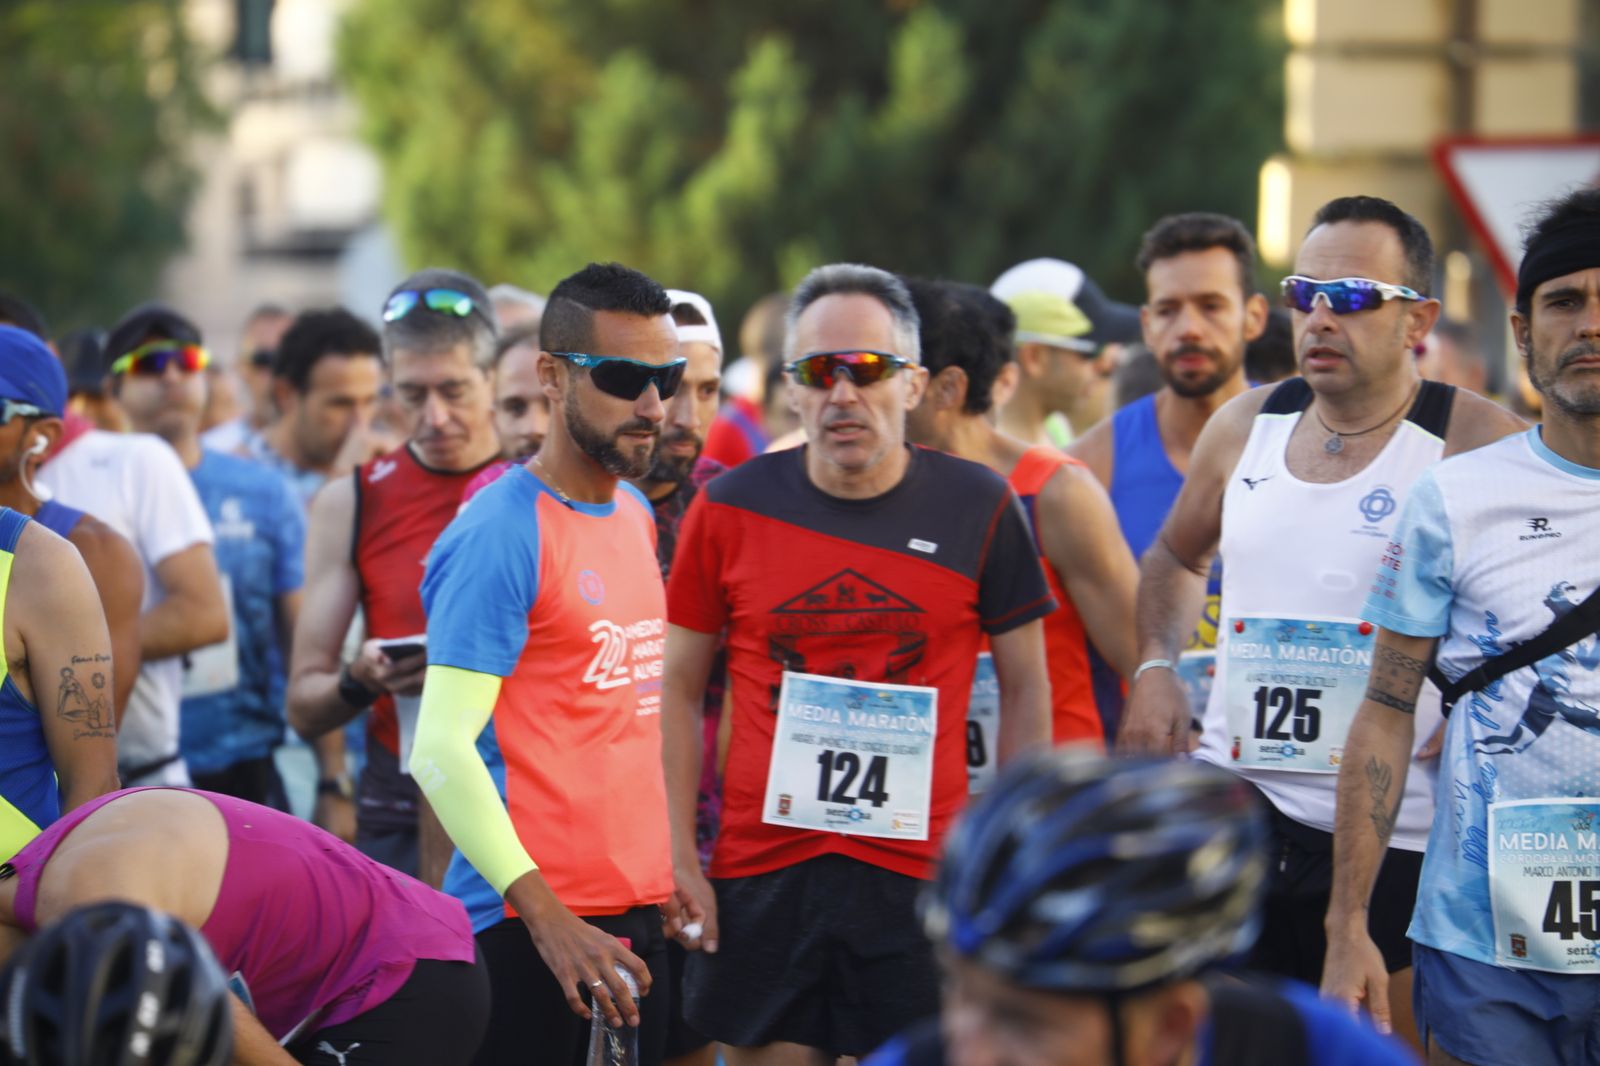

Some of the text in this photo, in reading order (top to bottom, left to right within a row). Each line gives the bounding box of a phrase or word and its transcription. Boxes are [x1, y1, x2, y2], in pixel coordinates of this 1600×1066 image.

[632, 638, 665, 660] MARAT
[1230, 642, 1371, 666] MEDIA MARATÓN
[634, 659, 664, 680] ALME
[786, 702, 842, 725] MEDIA
[847, 708, 931, 732] MARATÓN
[1253, 685, 1323, 743] 125
[816, 749, 890, 808] 124
[1500, 832, 1600, 850] MEDIA M
[1523, 866, 1554, 877] MARCO
[1556, 866, 1593, 877] ANTONIO
